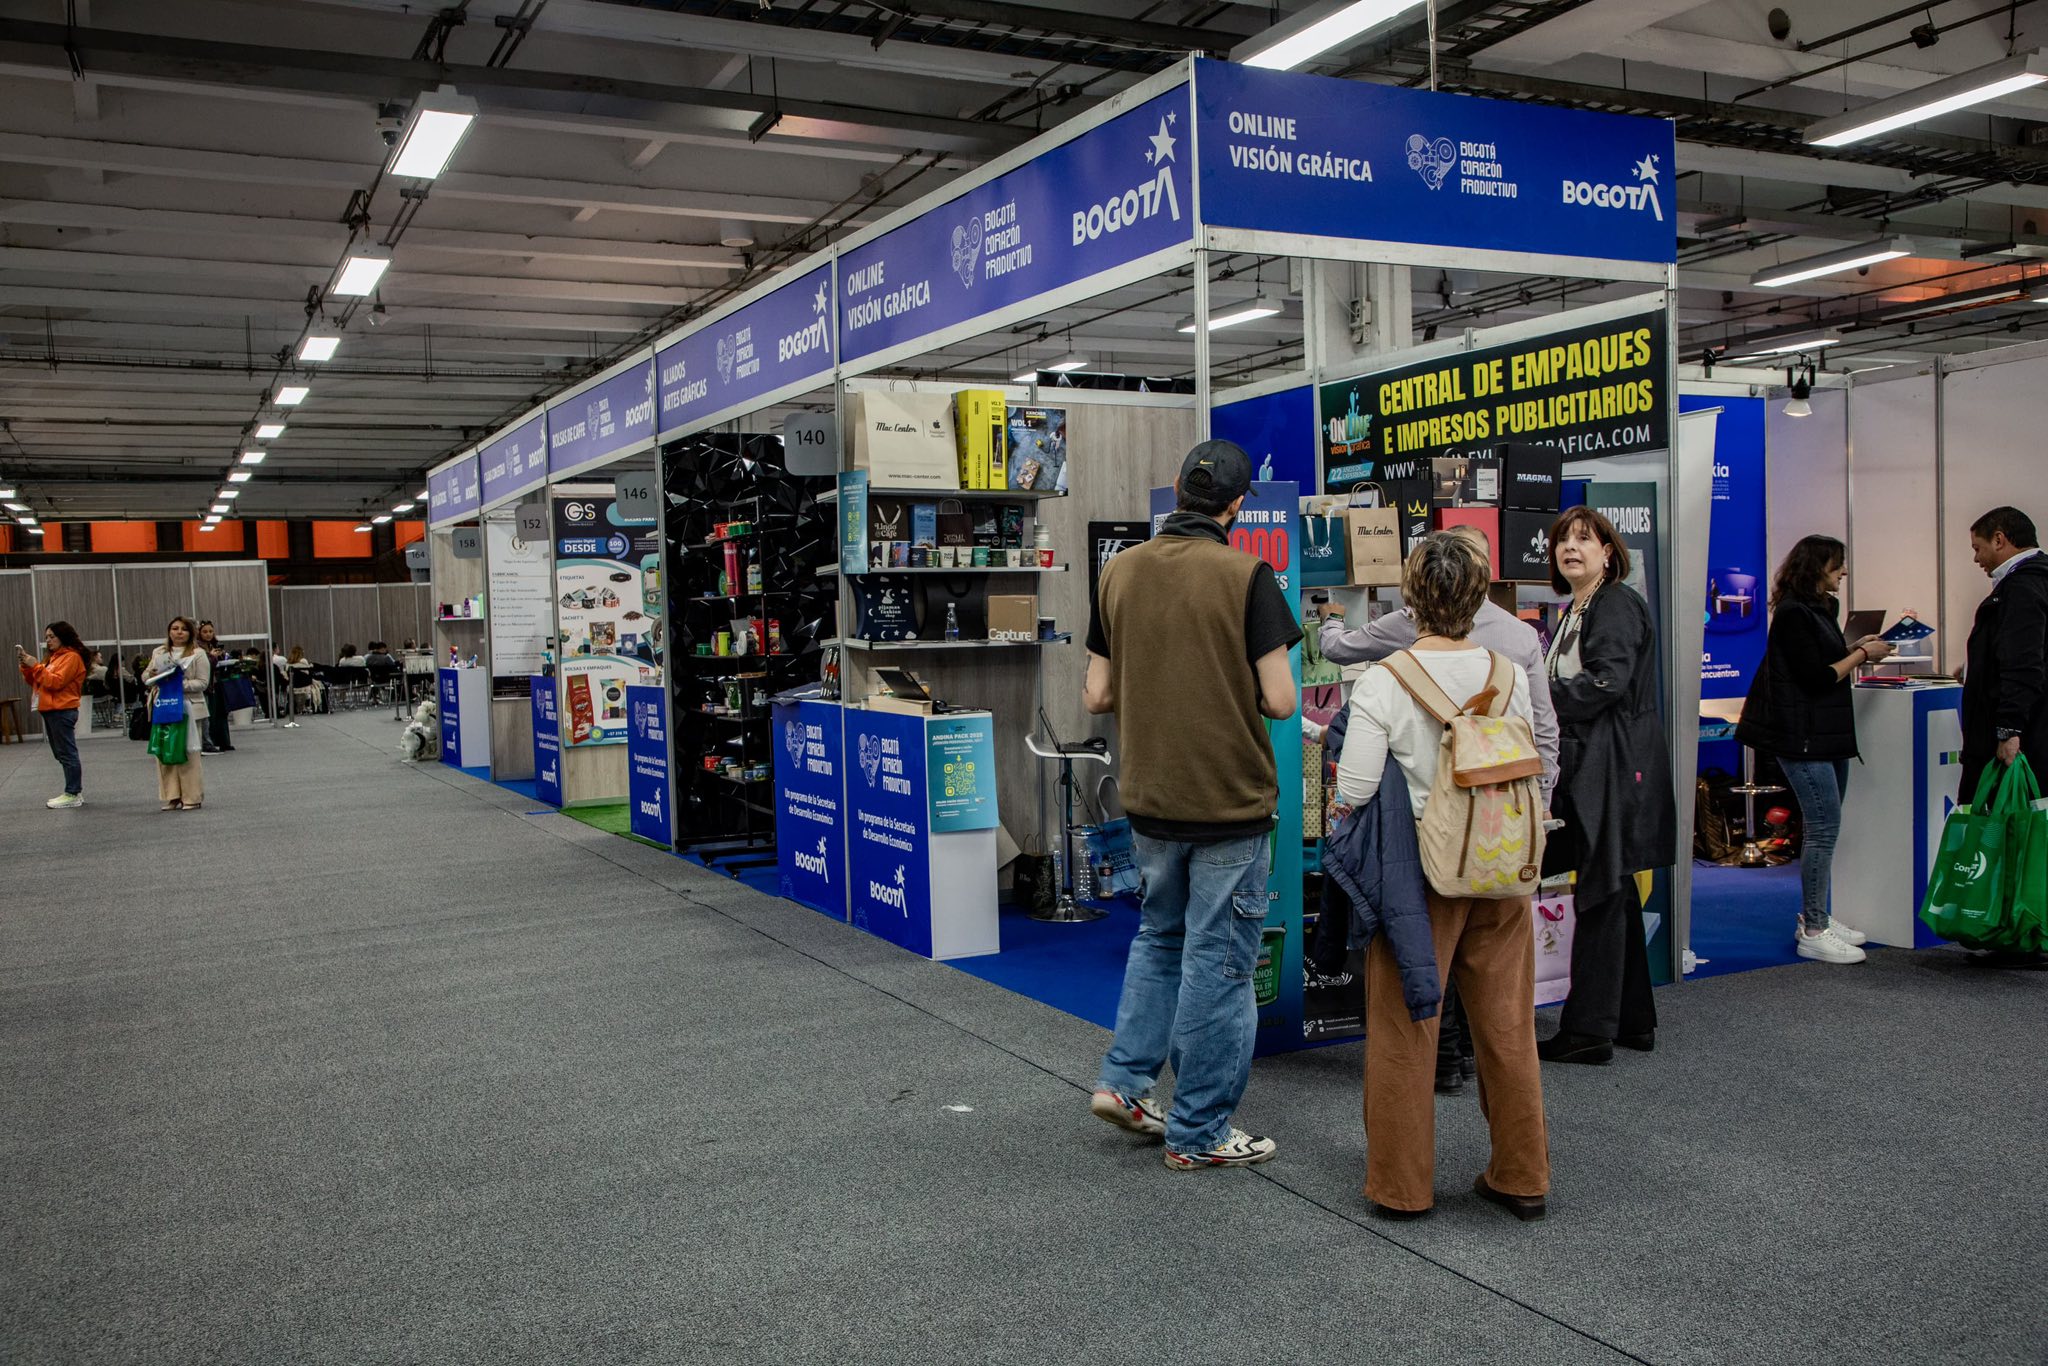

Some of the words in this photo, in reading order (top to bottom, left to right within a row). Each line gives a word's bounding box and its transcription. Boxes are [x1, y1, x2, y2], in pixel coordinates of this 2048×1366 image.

[1229, 111, 1297, 141] ONLINE
[1461, 141, 1496, 160] BOGOTÁ
[1229, 144, 1294, 175] VISIÓN
[1297, 151, 1373, 183] GRÁFICA
[1461, 160, 1503, 179] CORAZÓN
[1461, 179, 1518, 199] PRODUCTIVO
[985, 223, 1021, 256] CORAZÓN
[985, 244, 1032, 280] PRODUCTIVO
[847, 261, 884, 297] ONLINE
[847, 294, 881, 331] VISIÓN
[884, 281, 931, 318] GRÁFICA
[663, 361, 686, 387] ALIADOS
[1379, 364, 1466, 417] CENTRAL
[1472, 358, 1504, 398] DE
[1511, 328, 1652, 391] EMPAQUES
[663, 390, 680, 413] ARTES
[680, 378, 707, 406] GRÁFICAS
[1383, 427, 1394, 455] E
[1396, 409, 1490, 452] IMPRESOS
[1496, 379, 1653, 436] PUBLICITARIOS
[875, 421, 893, 432] Mac
[893, 421, 917, 433] Center
[795, 429, 825, 446] 140
[1331, 467, 1342, 480] 22
[1516, 472, 1553, 483] MAGMA
[623, 488, 648, 499] 146
[523, 520, 541, 529] 152
[1272, 510, 1287, 523] DE
[1357, 526, 1372, 536] Mac
[1373, 526, 1394, 536] Center
[459, 539, 476, 548] 158
[564, 544, 597, 553] DESDE
[412, 551, 426, 559] 164
[1522, 551, 1540, 564] Casa
[988, 628, 1032, 643] Capture
[790, 789, 807, 803] programa
[793, 805, 813, 821] Desarrollo
[858, 809, 864, 820] Un
[864, 811, 883, 827] programa
[883, 815, 889, 826] de
[893, 817, 916, 836] Secretaría
[862, 827, 868, 839] de
[868, 828, 889, 847] Desarrollo
[889, 834, 913, 853] Económico
